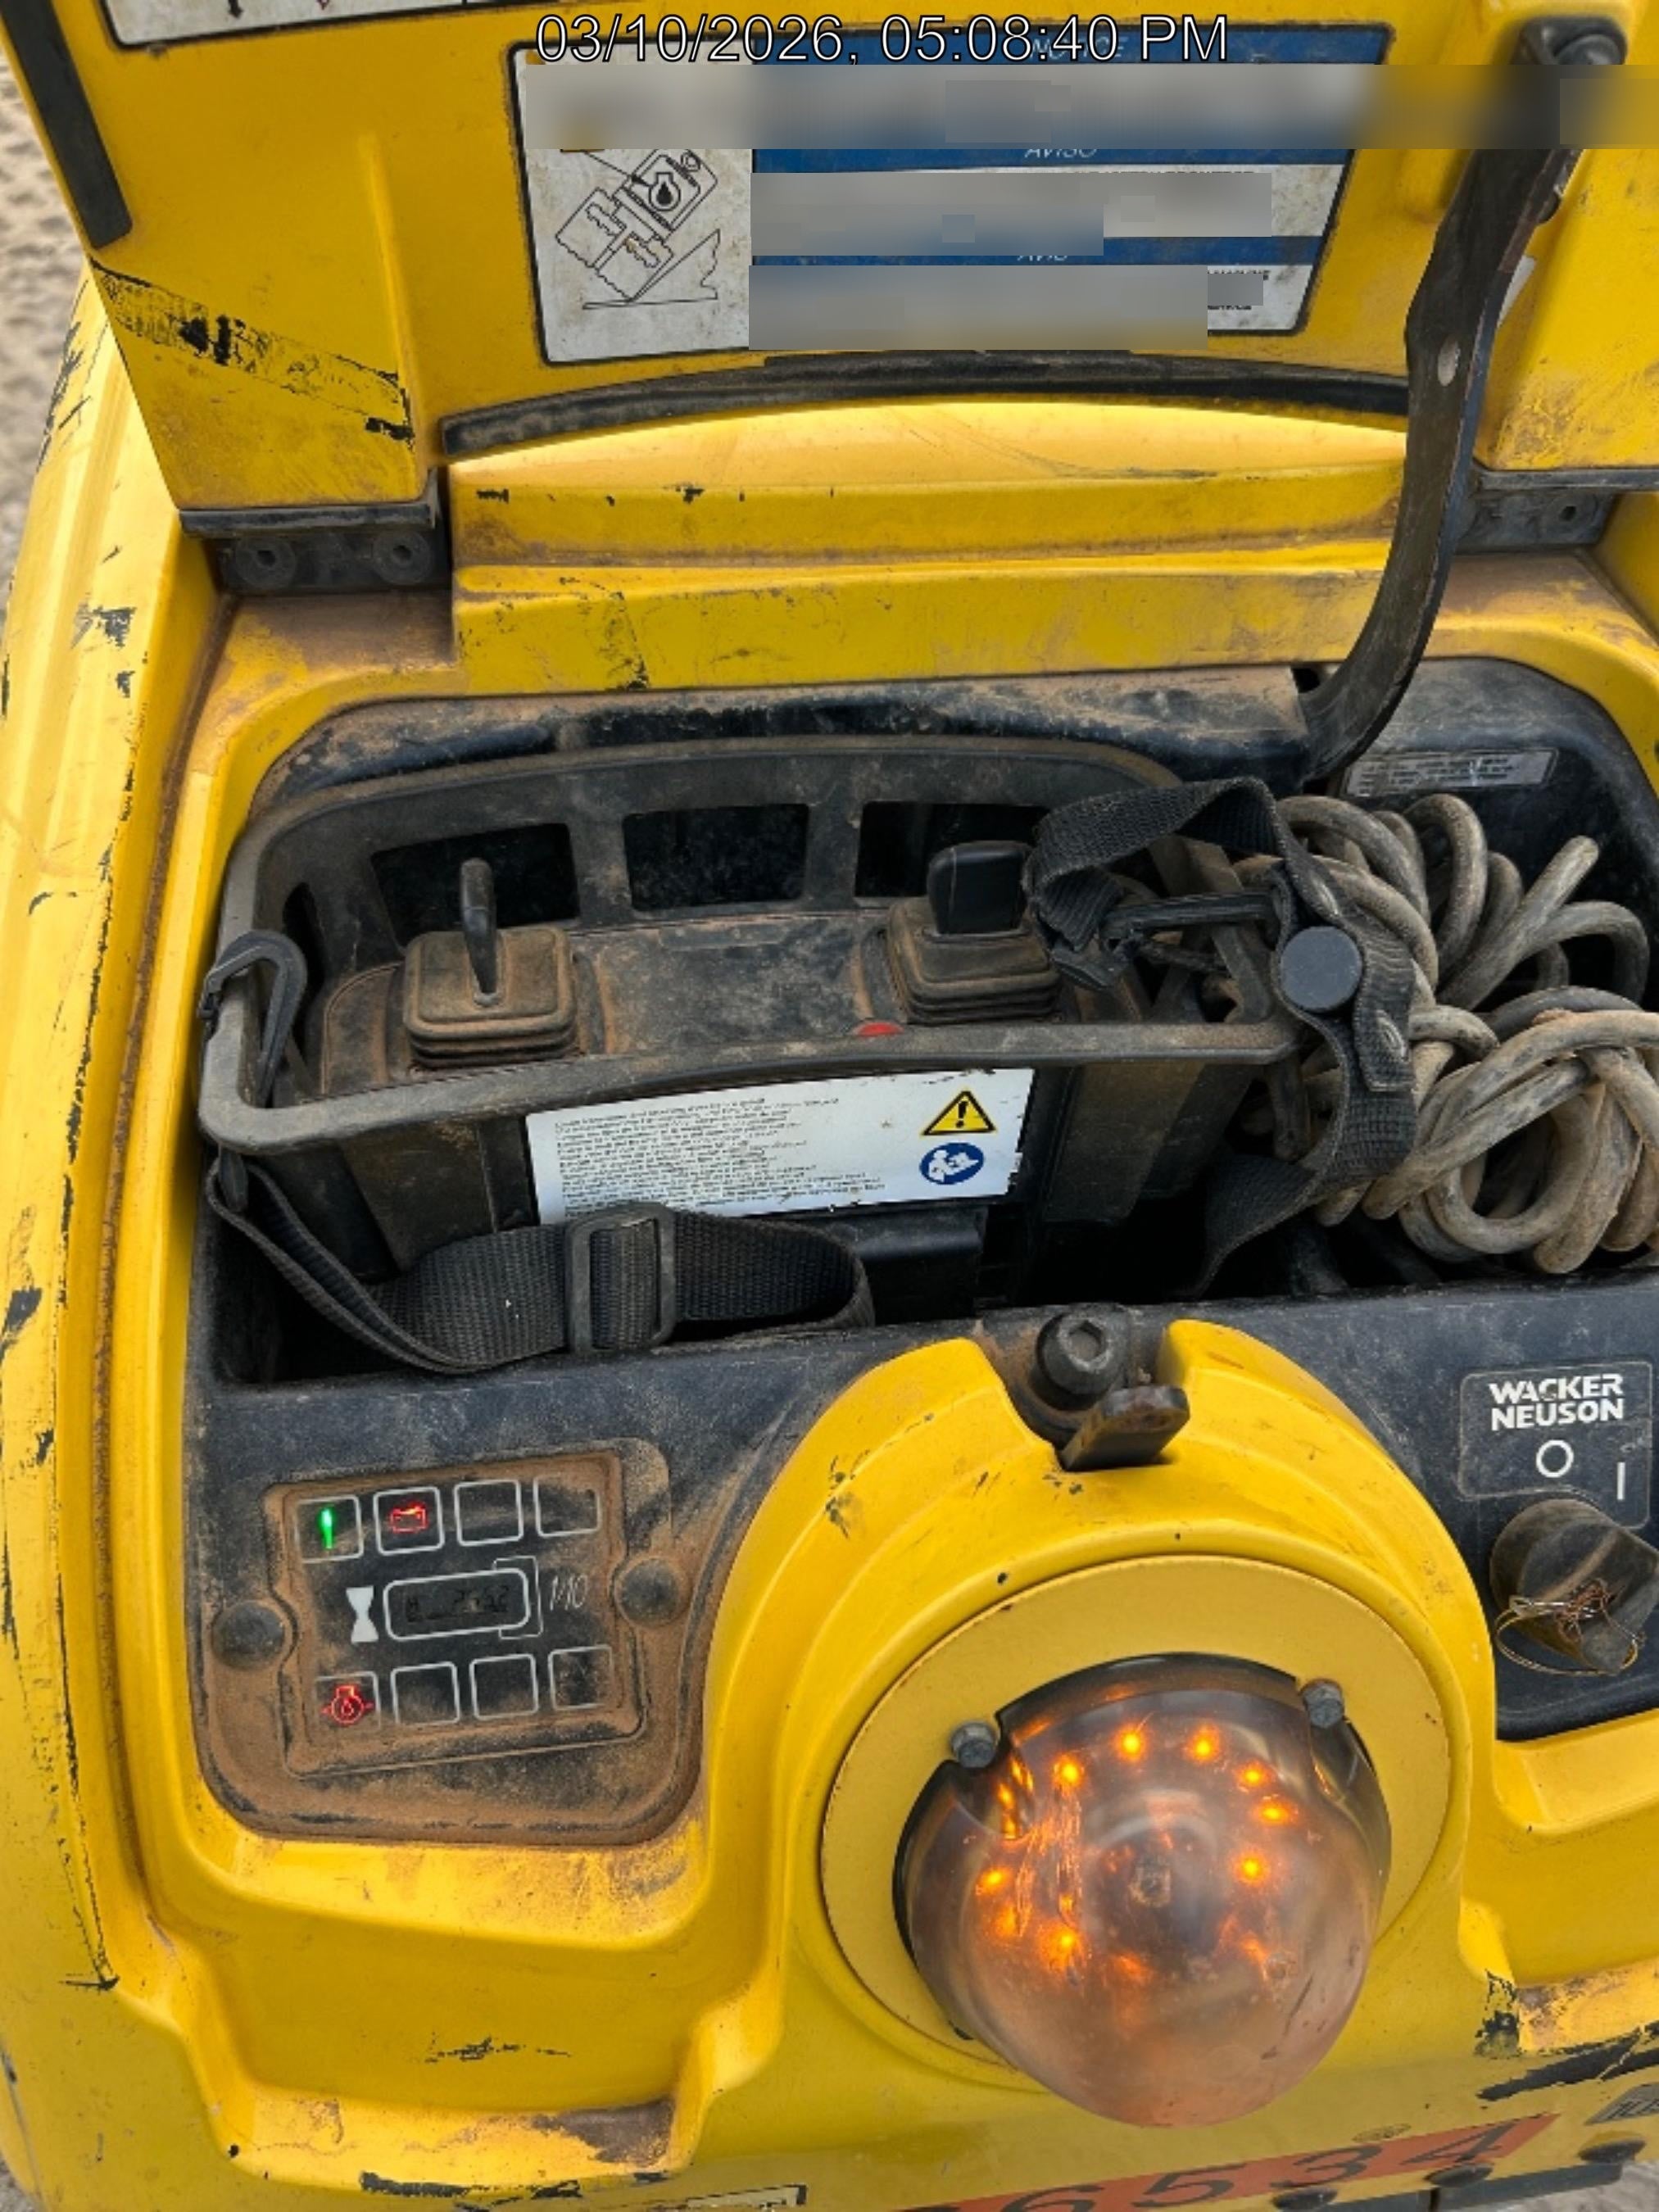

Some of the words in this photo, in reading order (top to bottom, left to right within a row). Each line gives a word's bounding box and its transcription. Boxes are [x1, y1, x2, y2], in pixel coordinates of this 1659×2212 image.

[1489, 1374, 1624, 1404] WACKER
[1491, 1398, 1624, 1431] NEUSON
[893, 2117, 1521, 2212] 6534
